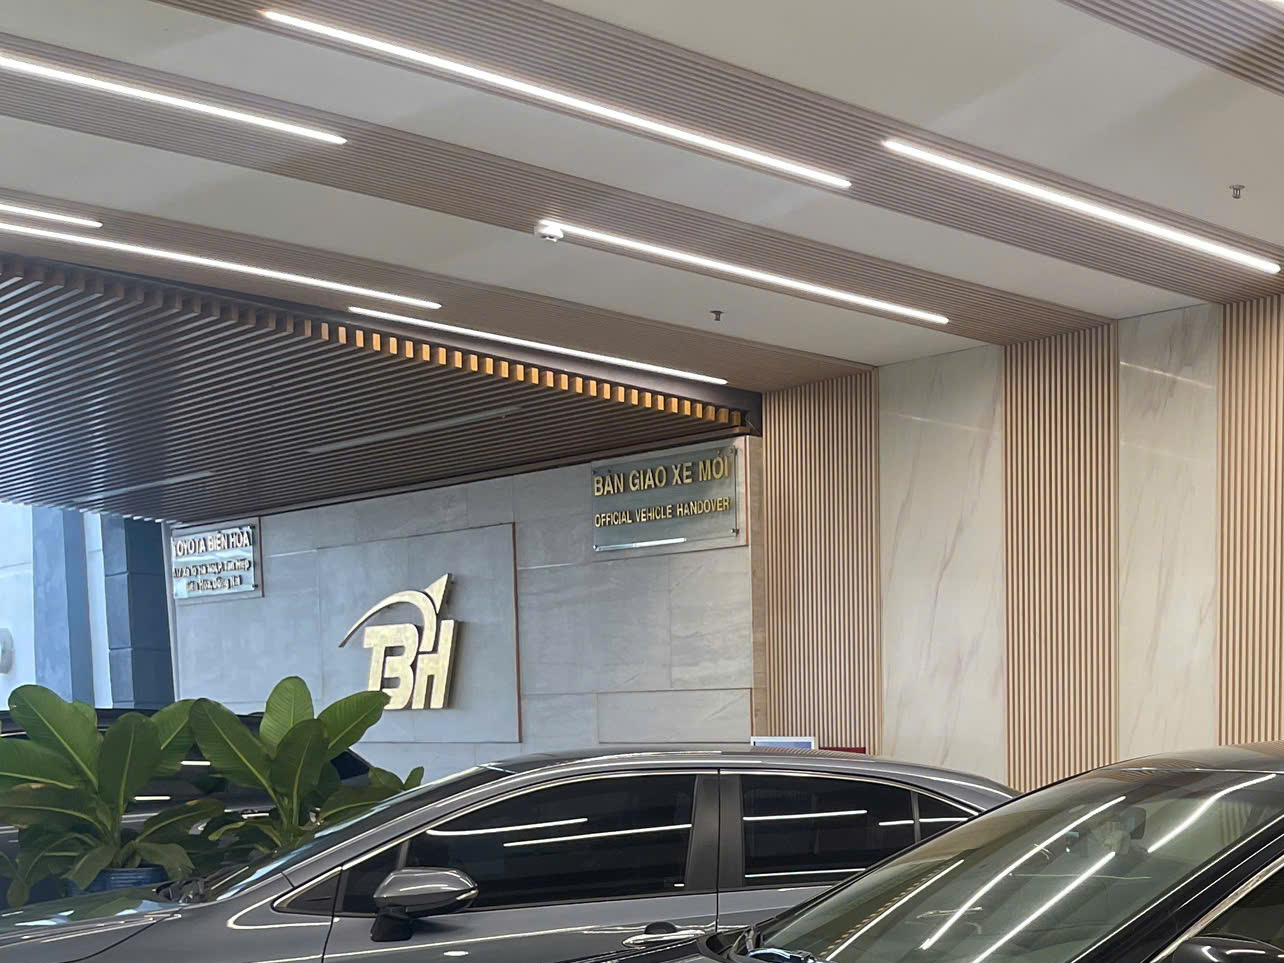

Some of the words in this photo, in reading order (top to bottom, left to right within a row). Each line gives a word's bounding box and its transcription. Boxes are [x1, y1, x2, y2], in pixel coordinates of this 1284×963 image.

[629, 466, 667, 491] GIAO
[671, 462, 693, 485] XE
[595, 510, 632, 528] OFFICIAL
[635, 504, 672, 522] VEHICLE
[677, 497, 730, 517] HANDOVER
